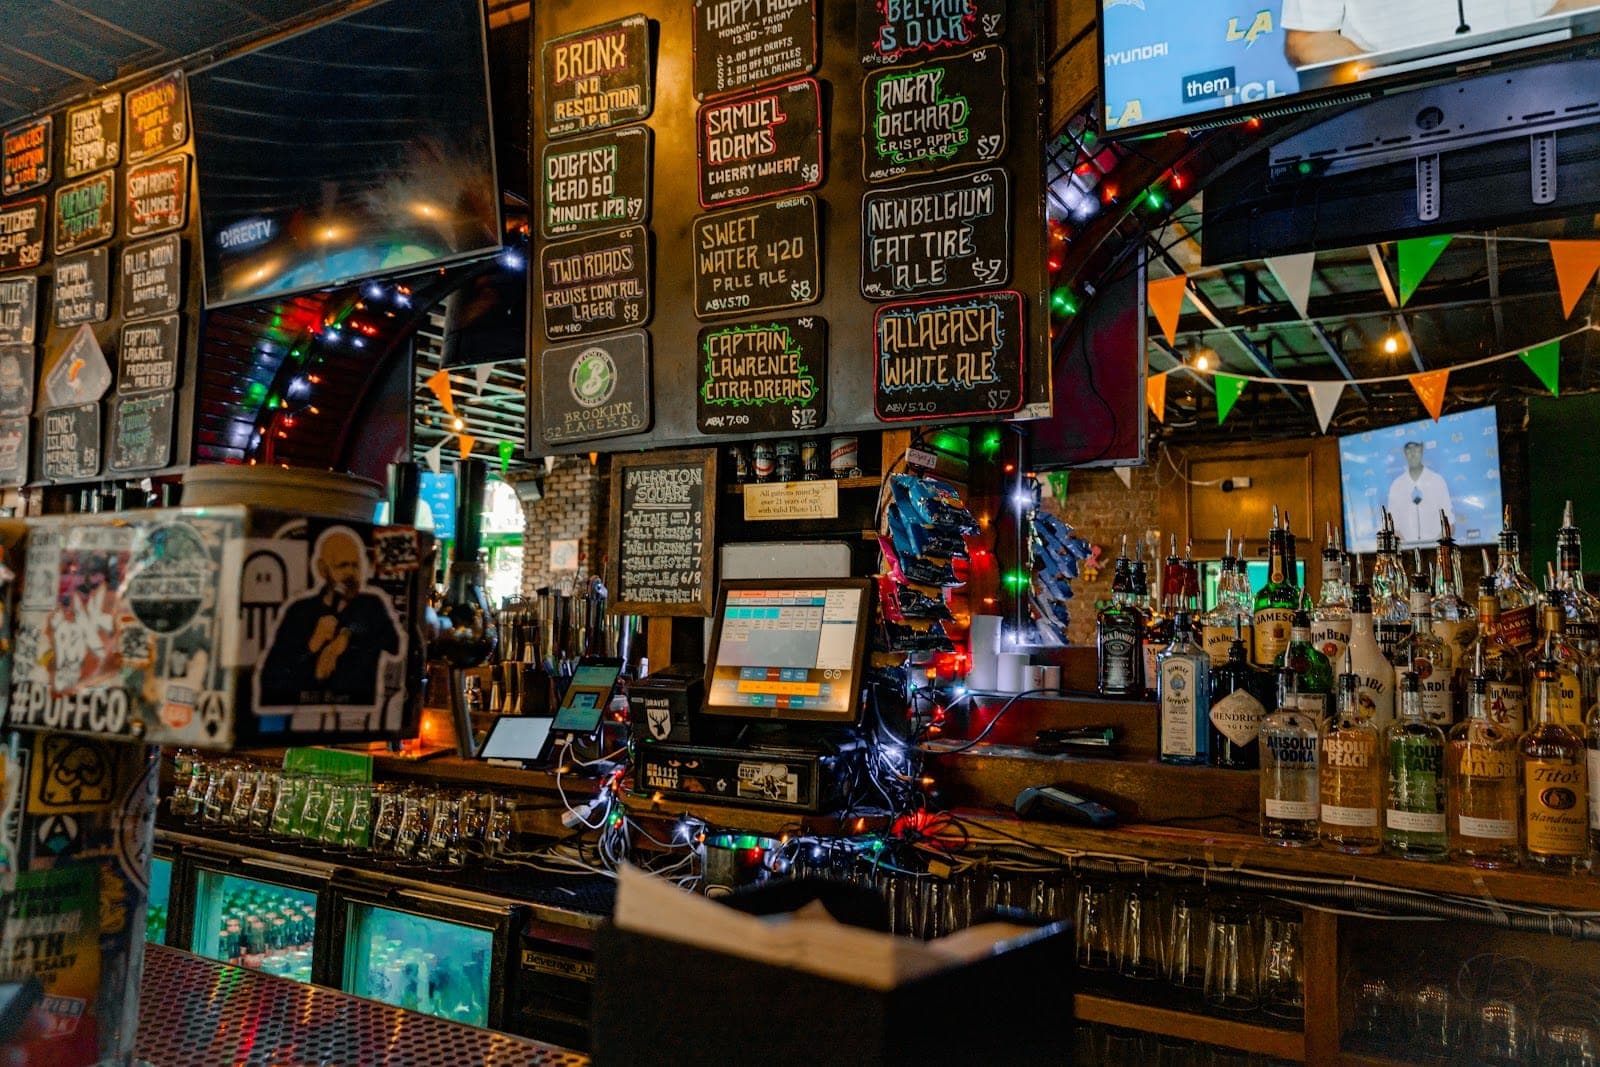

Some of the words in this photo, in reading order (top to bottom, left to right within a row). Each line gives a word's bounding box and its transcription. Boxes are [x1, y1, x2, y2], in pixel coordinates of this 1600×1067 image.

[707, 0, 760, 31] HAPPY
[719, 22, 751, 38] MONDAY
[762, 9, 793, 25] FRIDAY
[1225, 9, 1273, 44] LA
[881, 15, 969, 50] SOUR
[556, 33, 626, 83] BRONX
[749, 46, 762, 57] OFF
[764, 37, 793, 52] DRAFTS
[749, 58, 762, 70] OFF
[763, 47, 801, 66] BOTTLES
[749, 70, 769, 80] WELL
[771, 59, 802, 74] DRINKS
[577, 78, 598, 95] NO
[880, 72, 941, 109] ANGRY
[1186, 76, 1230, 97] them
[556, 88, 639, 119] RESOLUTION
[581, 112, 609, 127] IPA
[708, 97, 784, 136] SAMUEL
[879, 101, 965, 137] ORCHARD
[710, 130, 773, 162] ADAMS
[880, 138, 922, 152] CRISP
[927, 130, 966, 146] APPLE
[548, 148, 615, 180] DOGFISH
[896, 146, 947, 161] CIDER
[709, 163, 756, 185] CHERRY
[759, 156, 801, 177] WHEAT
[130, 173, 148, 199] SAM
[149, 169, 176, 193] ADAMS
[549, 179, 588, 203] HEAD
[592, 175, 613, 196] 60
[134, 195, 175, 219] SUMMER
[550, 202, 598, 224] MINUTE
[603, 199, 624, 217] IPA
[872, 199, 907, 231] NEW
[911, 187, 992, 226] BELGIUM
[220, 219, 271, 248] DIRECTV
[702, 215, 759, 250] SWEET
[700, 245, 760, 275] WATER
[767, 237, 803, 264] 420
[873, 234, 915, 267] FAT
[920, 227, 972, 258] TIRE
[125, 251, 147, 276] BLUE
[149, 244, 173, 267] MOON
[550, 258, 580, 282] TWO
[584, 248, 632, 277] ROADS
[133, 268, 166, 290] BELGIAN
[713, 275, 753, 292] PALE
[759, 269, 787, 288] ALE
[791, 280, 811, 301] $8
[896, 259, 944, 288] ALE
[545, 287, 588, 307] CRUISE
[591, 280, 643, 300] CONTROL
[574, 301, 614, 319] LAGER
[125, 328, 160, 346] CAPTAIN
[883, 307, 998, 353] ALLAGASH
[124, 346, 163, 361] LAWRENCE
[710, 331, 786, 357] CAPTAIN
[712, 354, 799, 379] LAWRENCE
[884, 355, 949, 386] WHITE
[957, 352, 993, 386] ALE
[48, 413, 75, 434] CONEY
[564, 401, 634, 423] BROOKLYN
[791, 406, 817, 429] $12
[565, 418, 619, 434] LAGER
[48, 433, 77, 450] ISLAND
[626, 468, 702, 489] MERRION
[635, 485, 691, 503] SQUARE
[784, 499, 798, 507] years
[790, 505, 808, 513] Photo
[693, 543, 702, 554] 7
[692, 557, 702, 568] 7
[681, 571, 701, 584] 6/8
[1256, 612, 1296, 624] JAMESO
[9, 682, 128, 733] #PUFFCO
[1266, 735, 1318, 750] ABSOLUT
[1273, 750, 1314, 762] VODKA
[1327, 753, 1369, 768] PEACH
[648, 778, 679, 789] ARMY
[1534, 768, 1580, 782] Tito's
